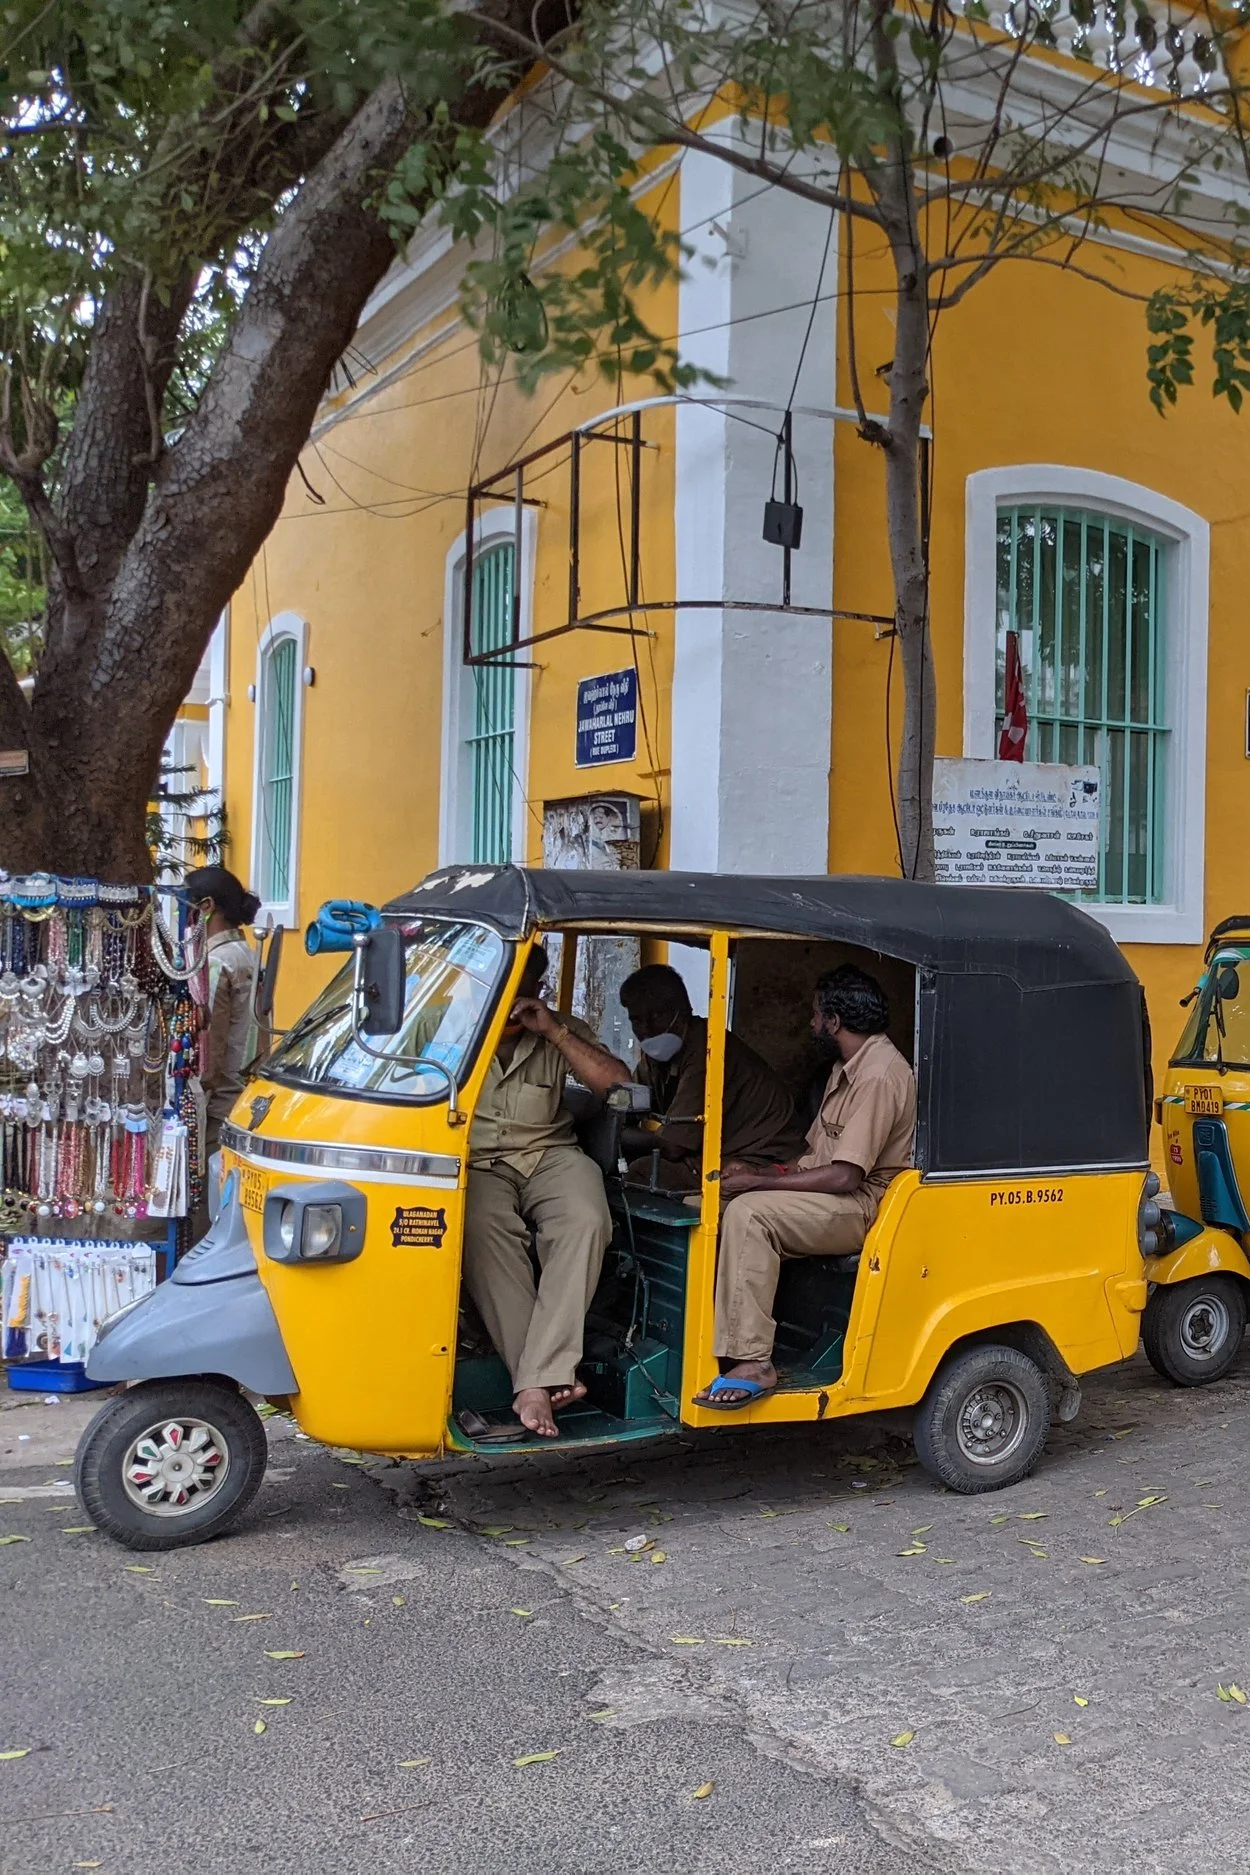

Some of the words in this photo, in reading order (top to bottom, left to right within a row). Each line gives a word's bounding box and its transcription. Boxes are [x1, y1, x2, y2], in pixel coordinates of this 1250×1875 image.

[578, 715, 613, 732] JAWAHARLAL
[614, 710, 634, 726] NEHRU
[594, 729, 615, 745] STREET
[1194, 1088, 1212, 1100] PY01
[1191, 1101, 1219, 1113] BM0419
[990, 1189, 1064, 1206] PY.05.B.9562
